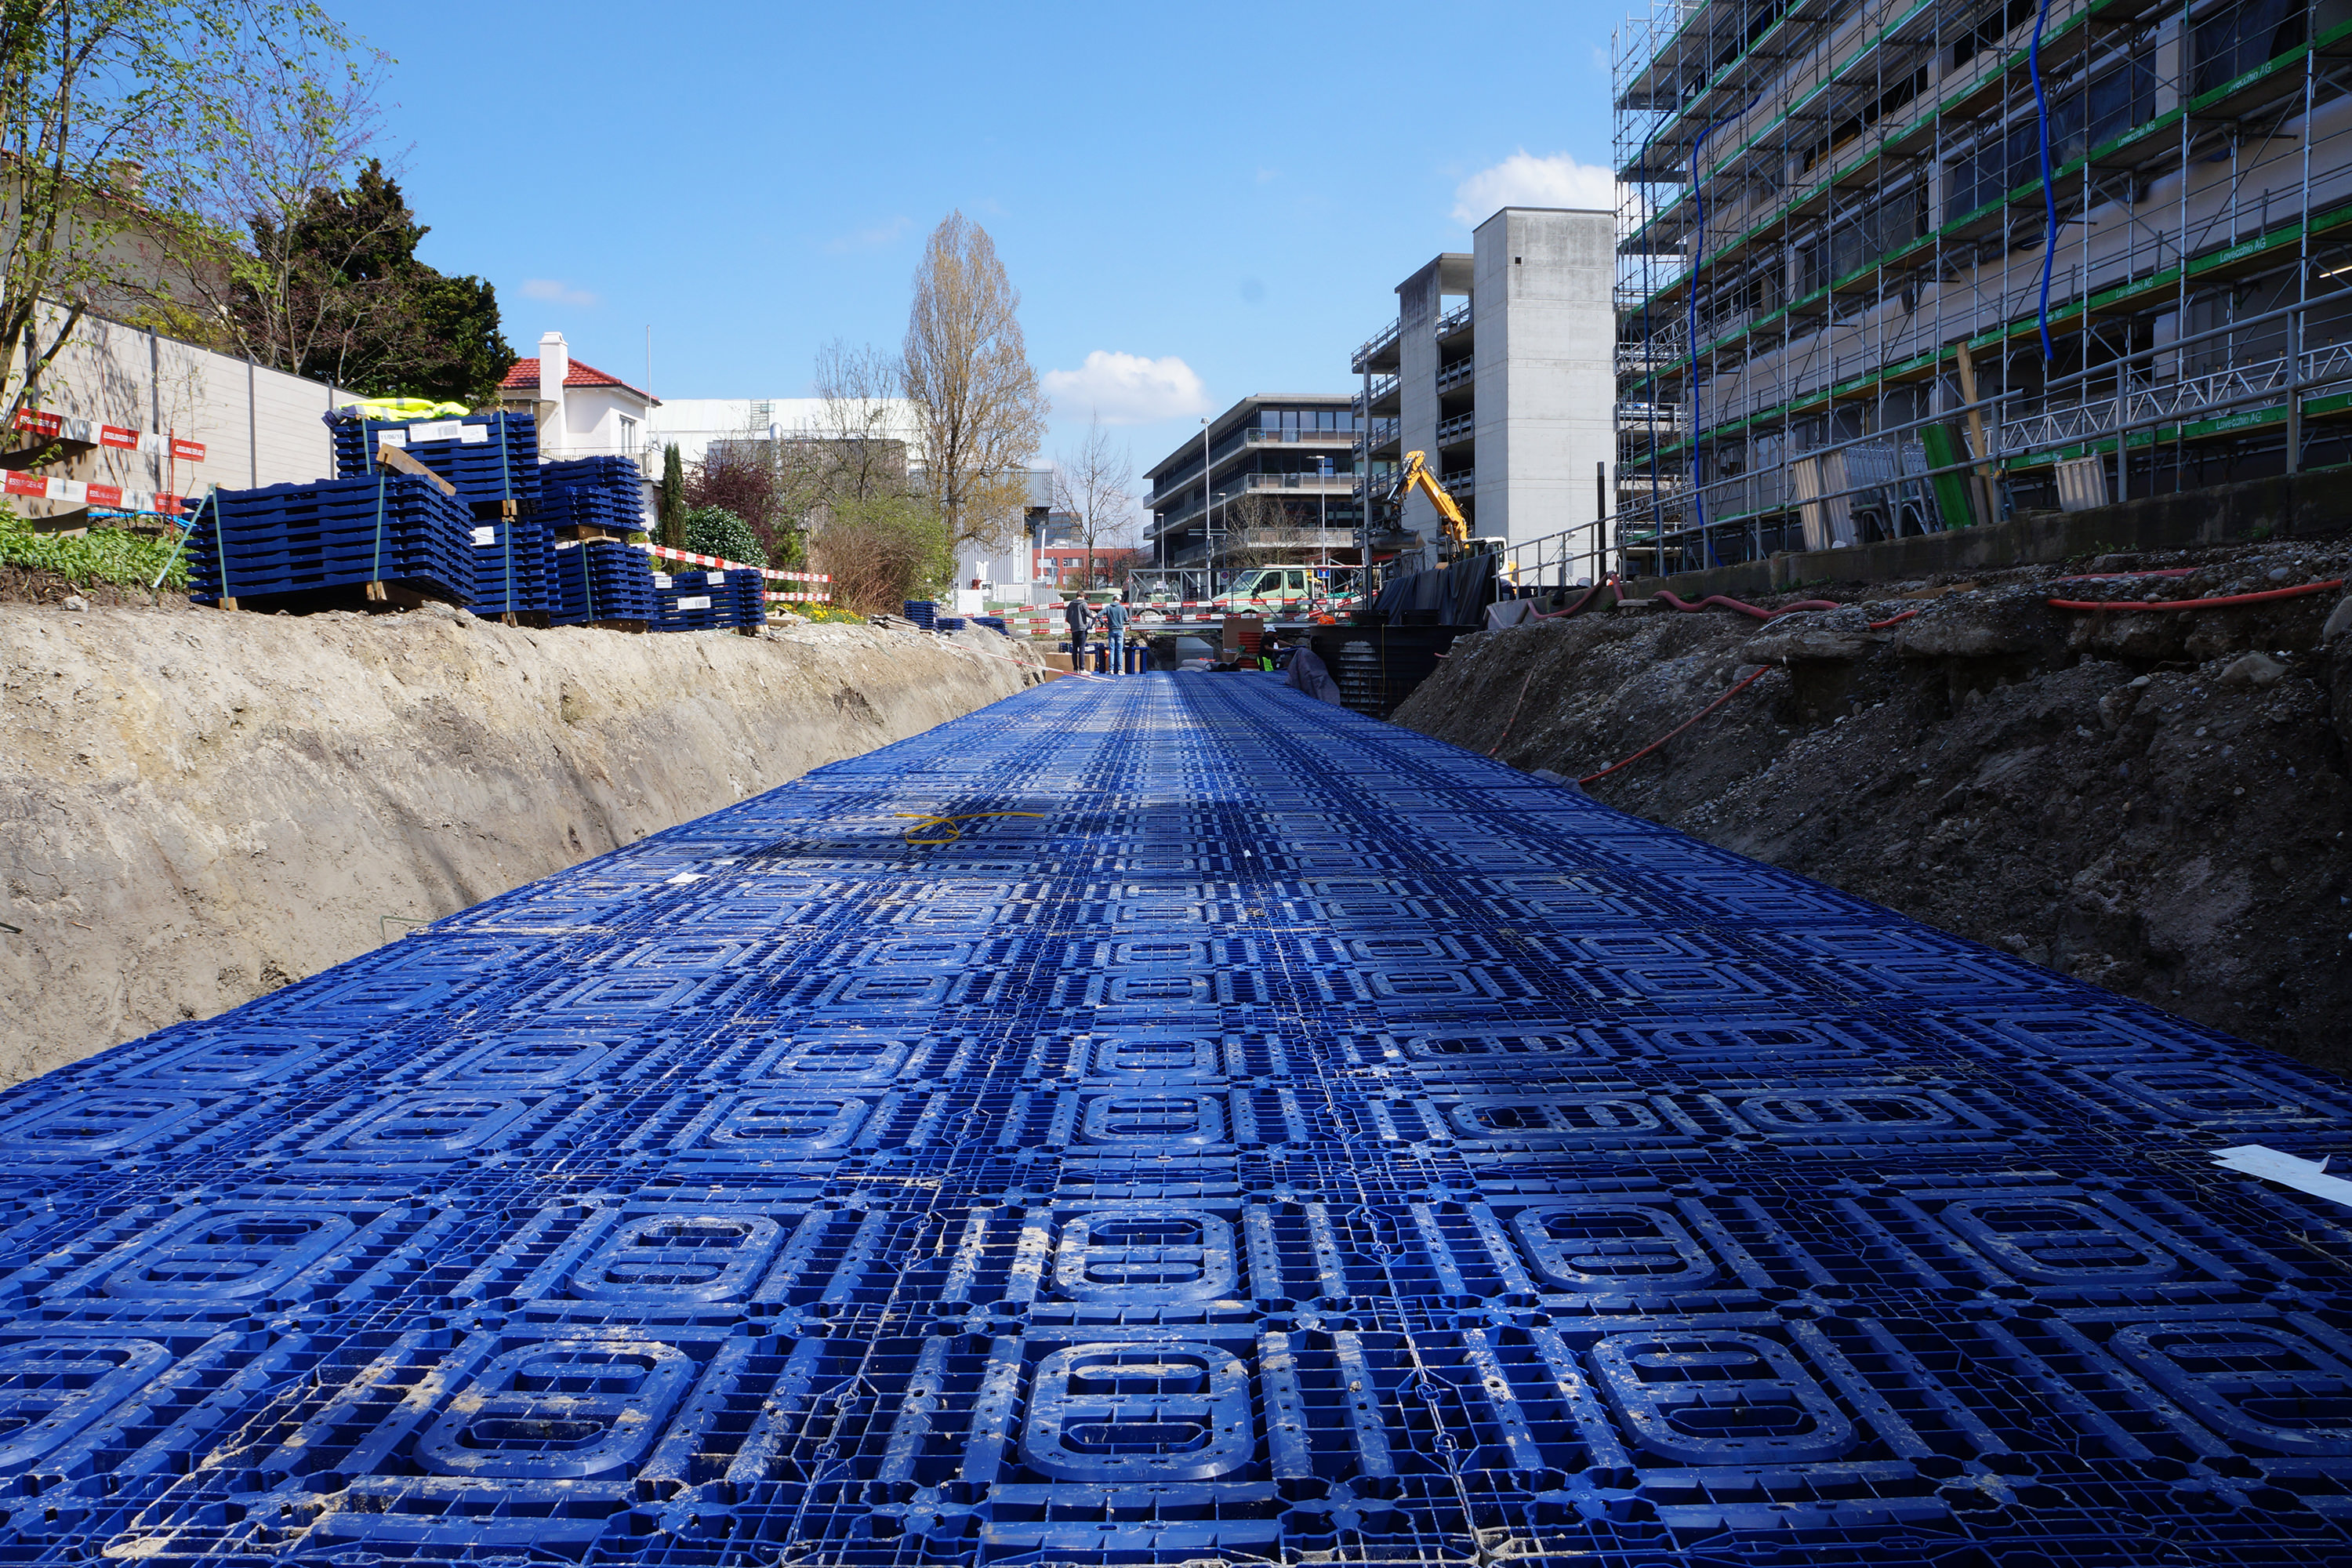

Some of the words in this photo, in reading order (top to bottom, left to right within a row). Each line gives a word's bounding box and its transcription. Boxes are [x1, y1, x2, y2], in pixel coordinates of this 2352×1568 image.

[2226, 70, 2258, 93] ovecchio
[2259, 62, 2271, 77] AG
[2146, 121, 2155, 132] AG
[2220, 243, 2253, 263] Lovecchio
[2254, 238, 2266, 251] AG
[2143, 277, 2154, 289] AG
[20, 415, 49, 428] ESSLGER
[2216, 414, 2249, 430] Lovecchio
[2250, 412, 2262, 424] AG
